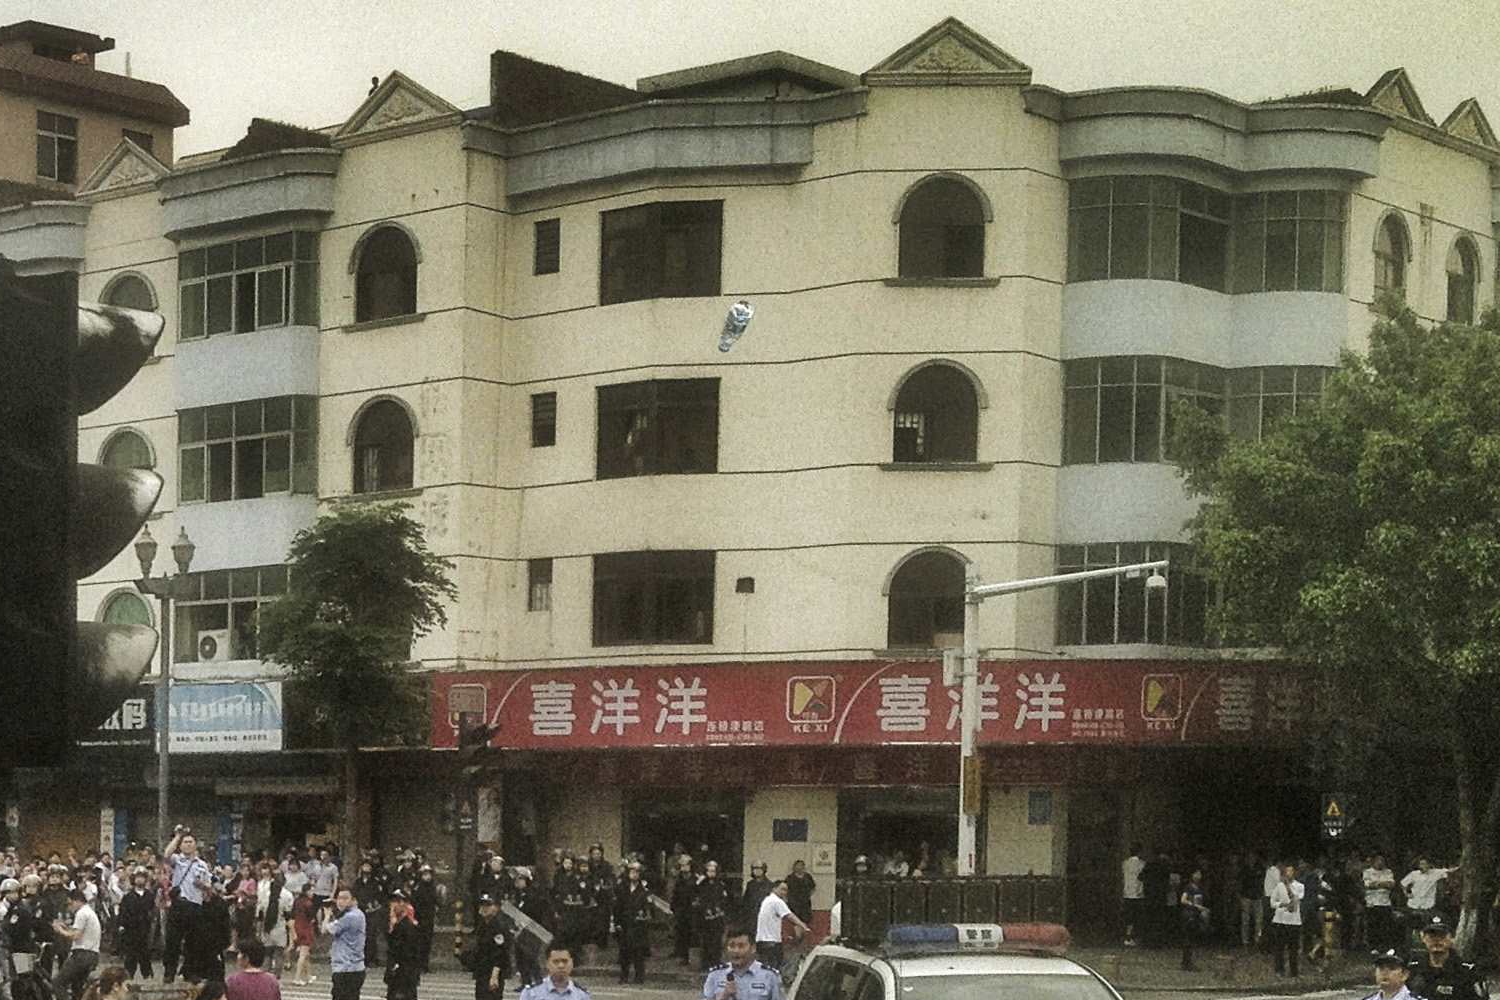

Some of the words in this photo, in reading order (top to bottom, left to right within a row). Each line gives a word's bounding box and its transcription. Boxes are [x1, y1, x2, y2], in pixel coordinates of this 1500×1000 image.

[529, 677, 708, 736] 喜洋洋
[876, 672, 1067, 732] 喜洋洋
